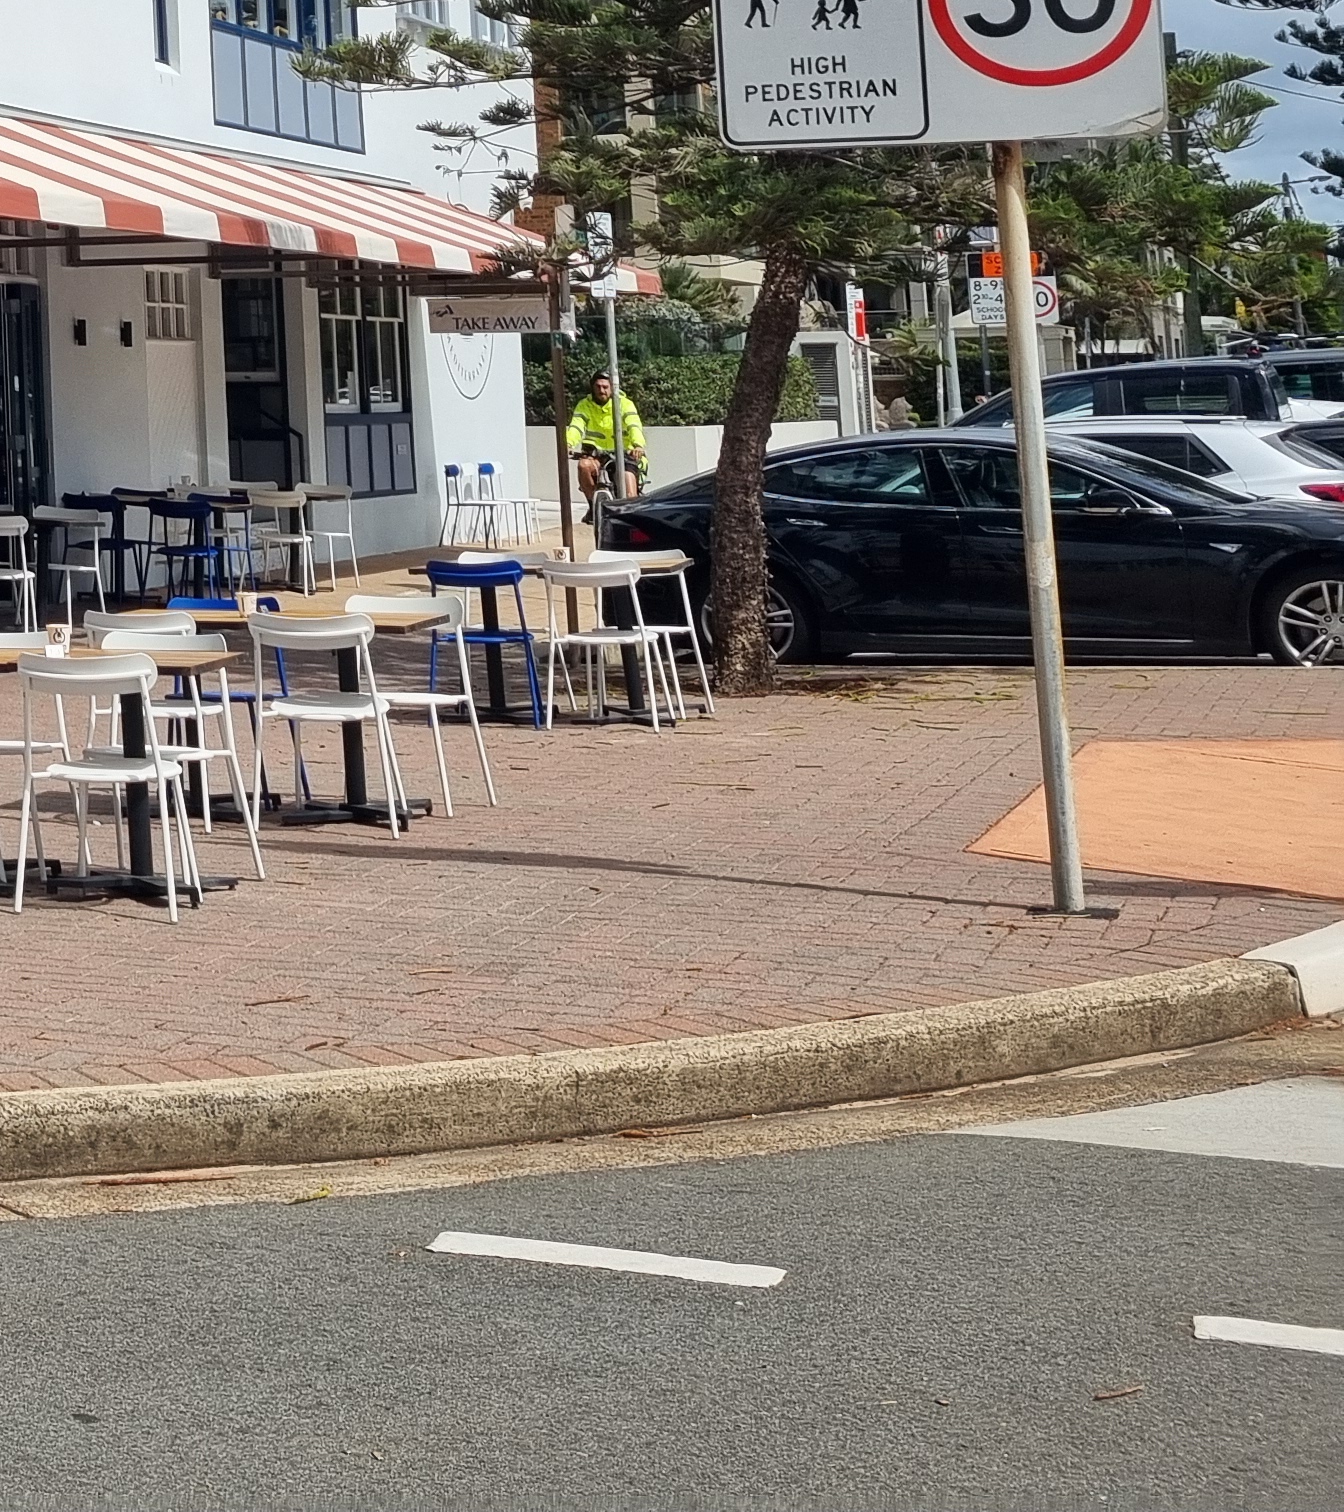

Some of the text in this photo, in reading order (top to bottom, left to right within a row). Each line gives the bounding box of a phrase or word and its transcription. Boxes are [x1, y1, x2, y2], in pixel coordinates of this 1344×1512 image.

[790, 55, 847, 76] HIGH
[744, 78, 897, 103] PEDESTRIAN
[768, 104, 875, 127] ACTIVITY
[1035, 291, 1049, 307] 0
[976, 306, 1004, 314] SCHOO
[452, 316, 538, 330] TAKE AWAY
